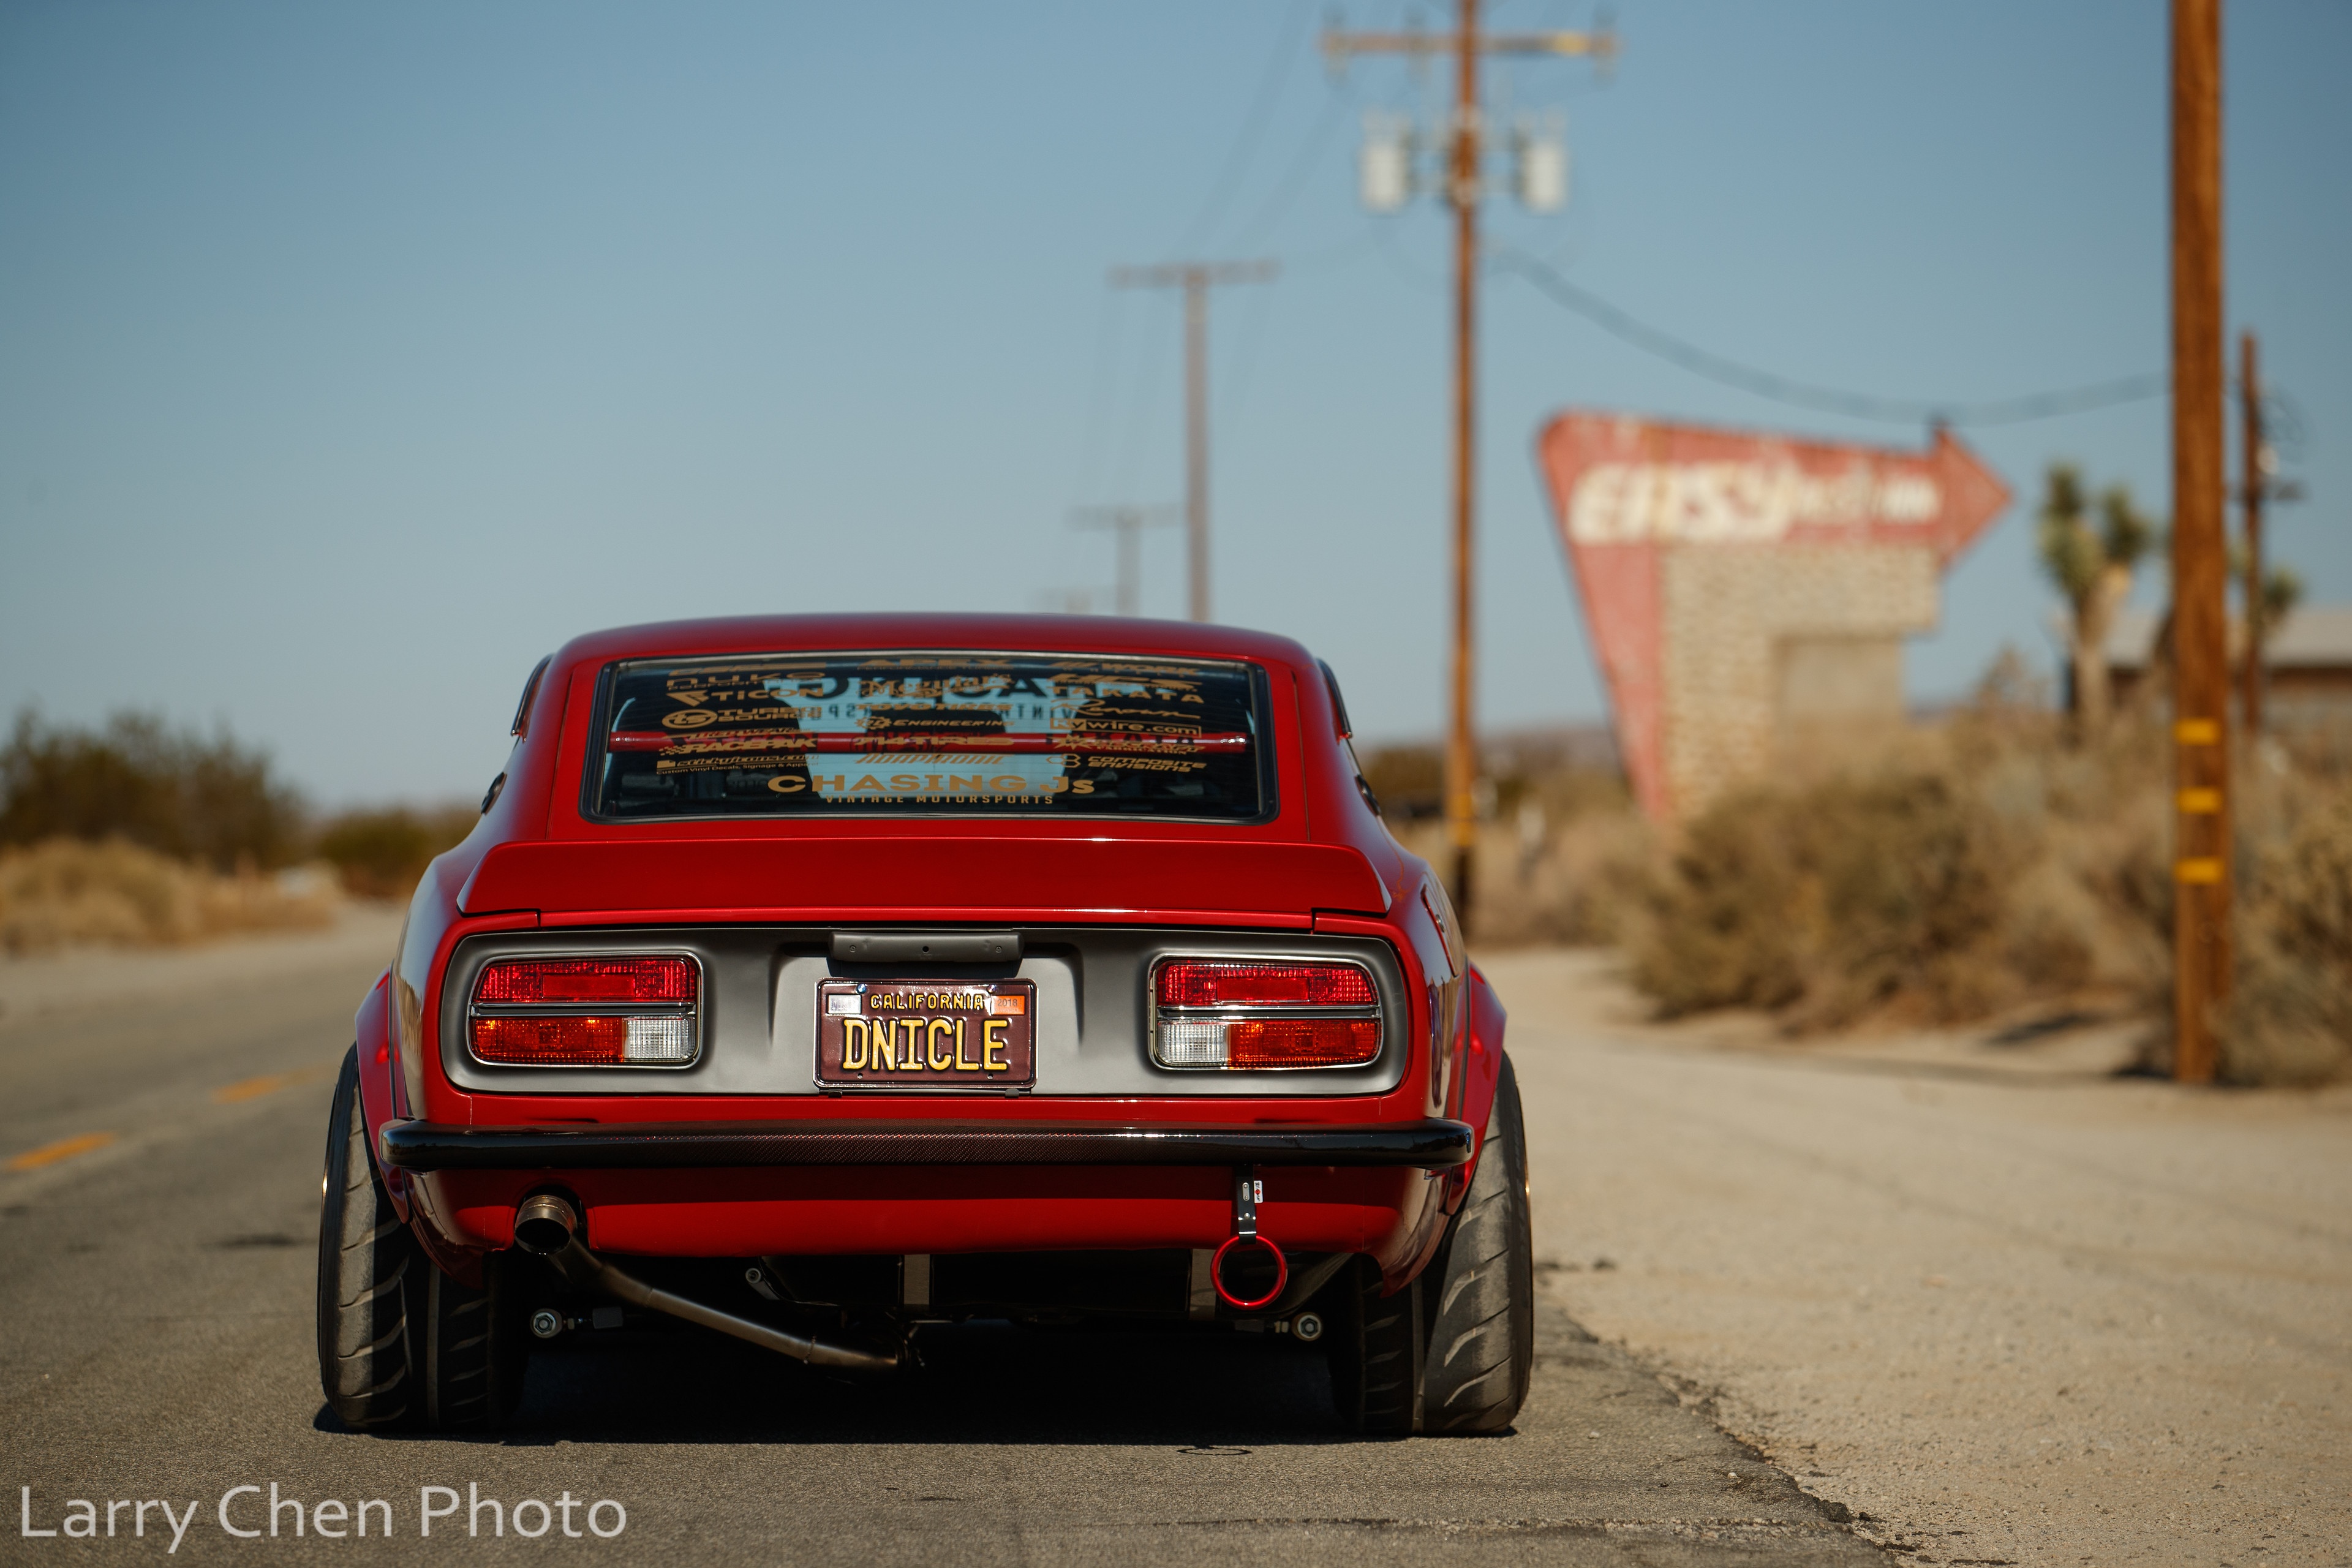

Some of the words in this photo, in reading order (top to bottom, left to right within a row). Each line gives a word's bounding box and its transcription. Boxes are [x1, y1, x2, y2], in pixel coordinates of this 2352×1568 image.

[711, 687, 824, 701] TICON
[1047, 686, 1204, 704] TAKATA
[718, 707, 822, 715] TURBO
[718, 712, 822, 722] SOURCE
[679, 738, 818, 754] RACEPAK
[767, 774, 1027, 793] CHASING
[826, 795, 904, 804] VINTAGE
[916, 795, 1053, 804] MOTORSPORTS
[871, 995, 984, 1010] CALIFORNIA
[997, 998, 1018, 1008] 2018
[843, 1019, 1008, 1071] DNICLE
